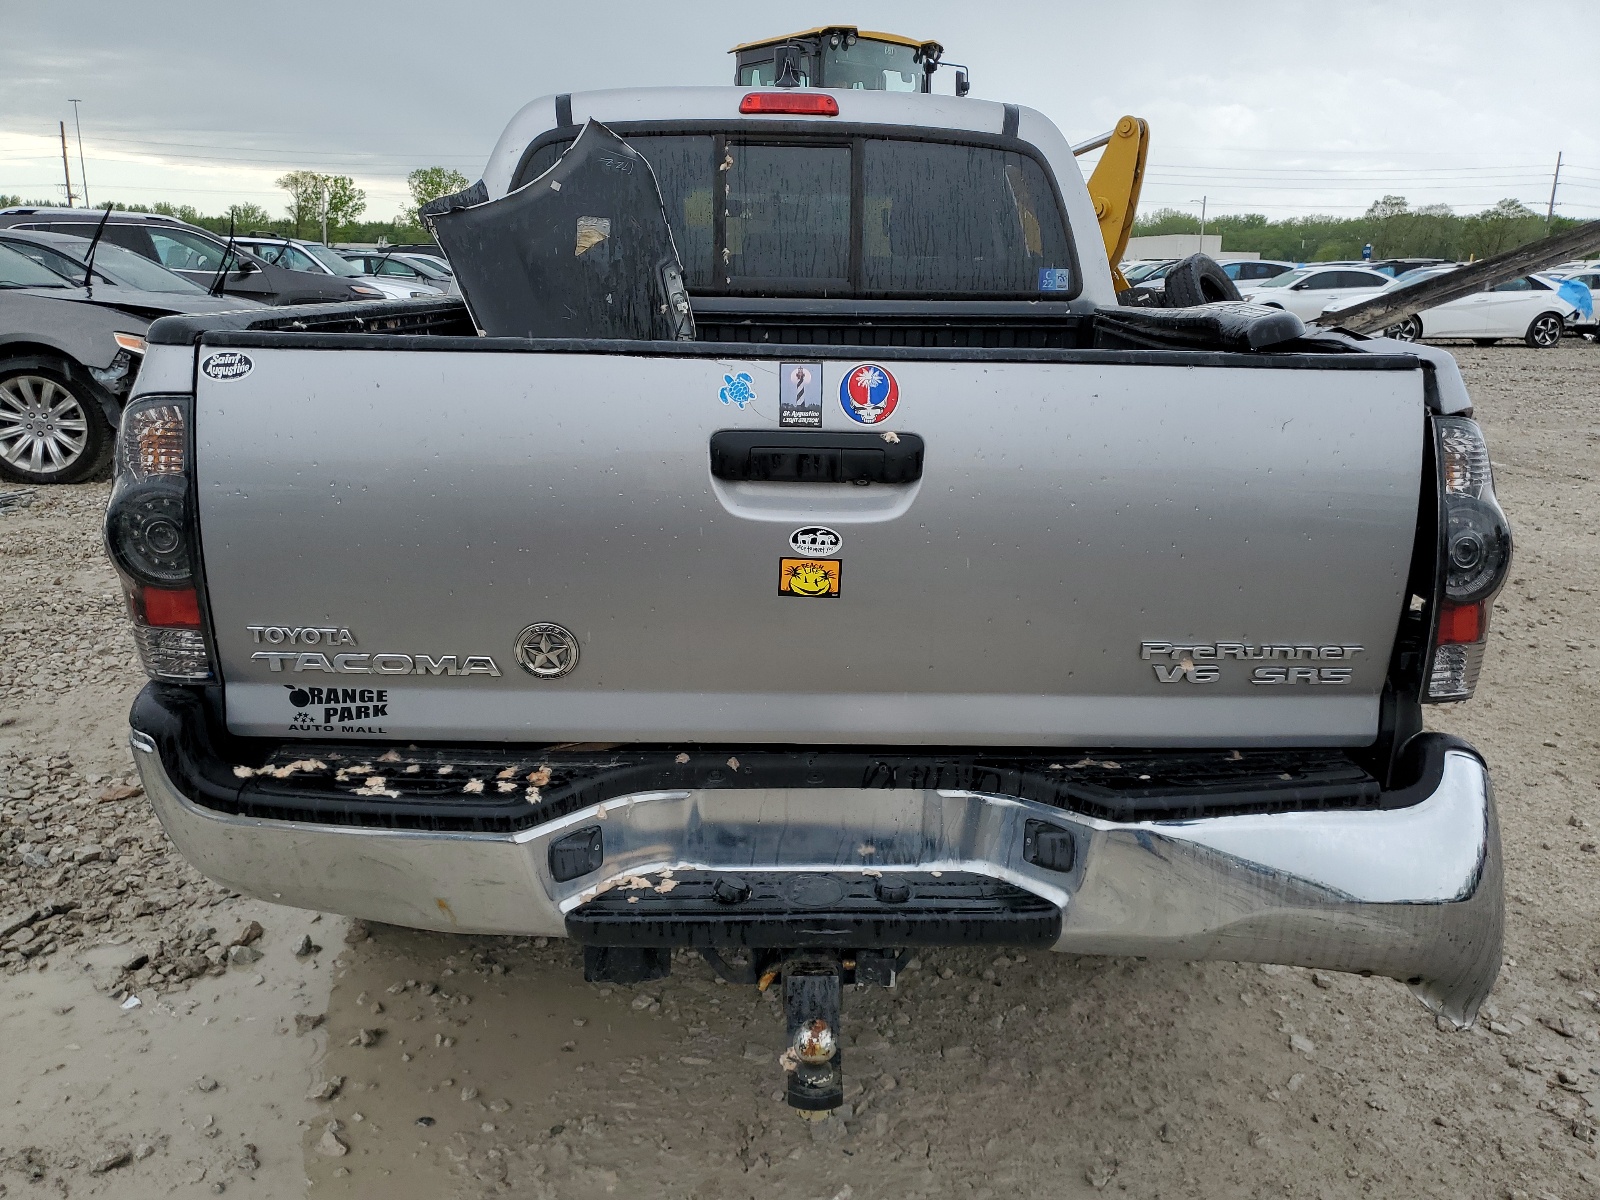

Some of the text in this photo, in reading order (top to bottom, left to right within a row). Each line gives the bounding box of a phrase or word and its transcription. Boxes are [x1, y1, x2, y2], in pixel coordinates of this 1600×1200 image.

[1042, 279, 1054, 288] 22
[210, 353, 241, 365] Saint
[206, 362, 250, 379] Augustine
[247, 625, 358, 647] TOYOTA
[1140, 641, 1366, 660] PreRunner
[250, 651, 503, 677] TACOMA
[1152, 663, 1353, 686] V6 SR5
[323, 704, 389, 724] PARK
[288, 723, 388, 735] AUTO MALL
